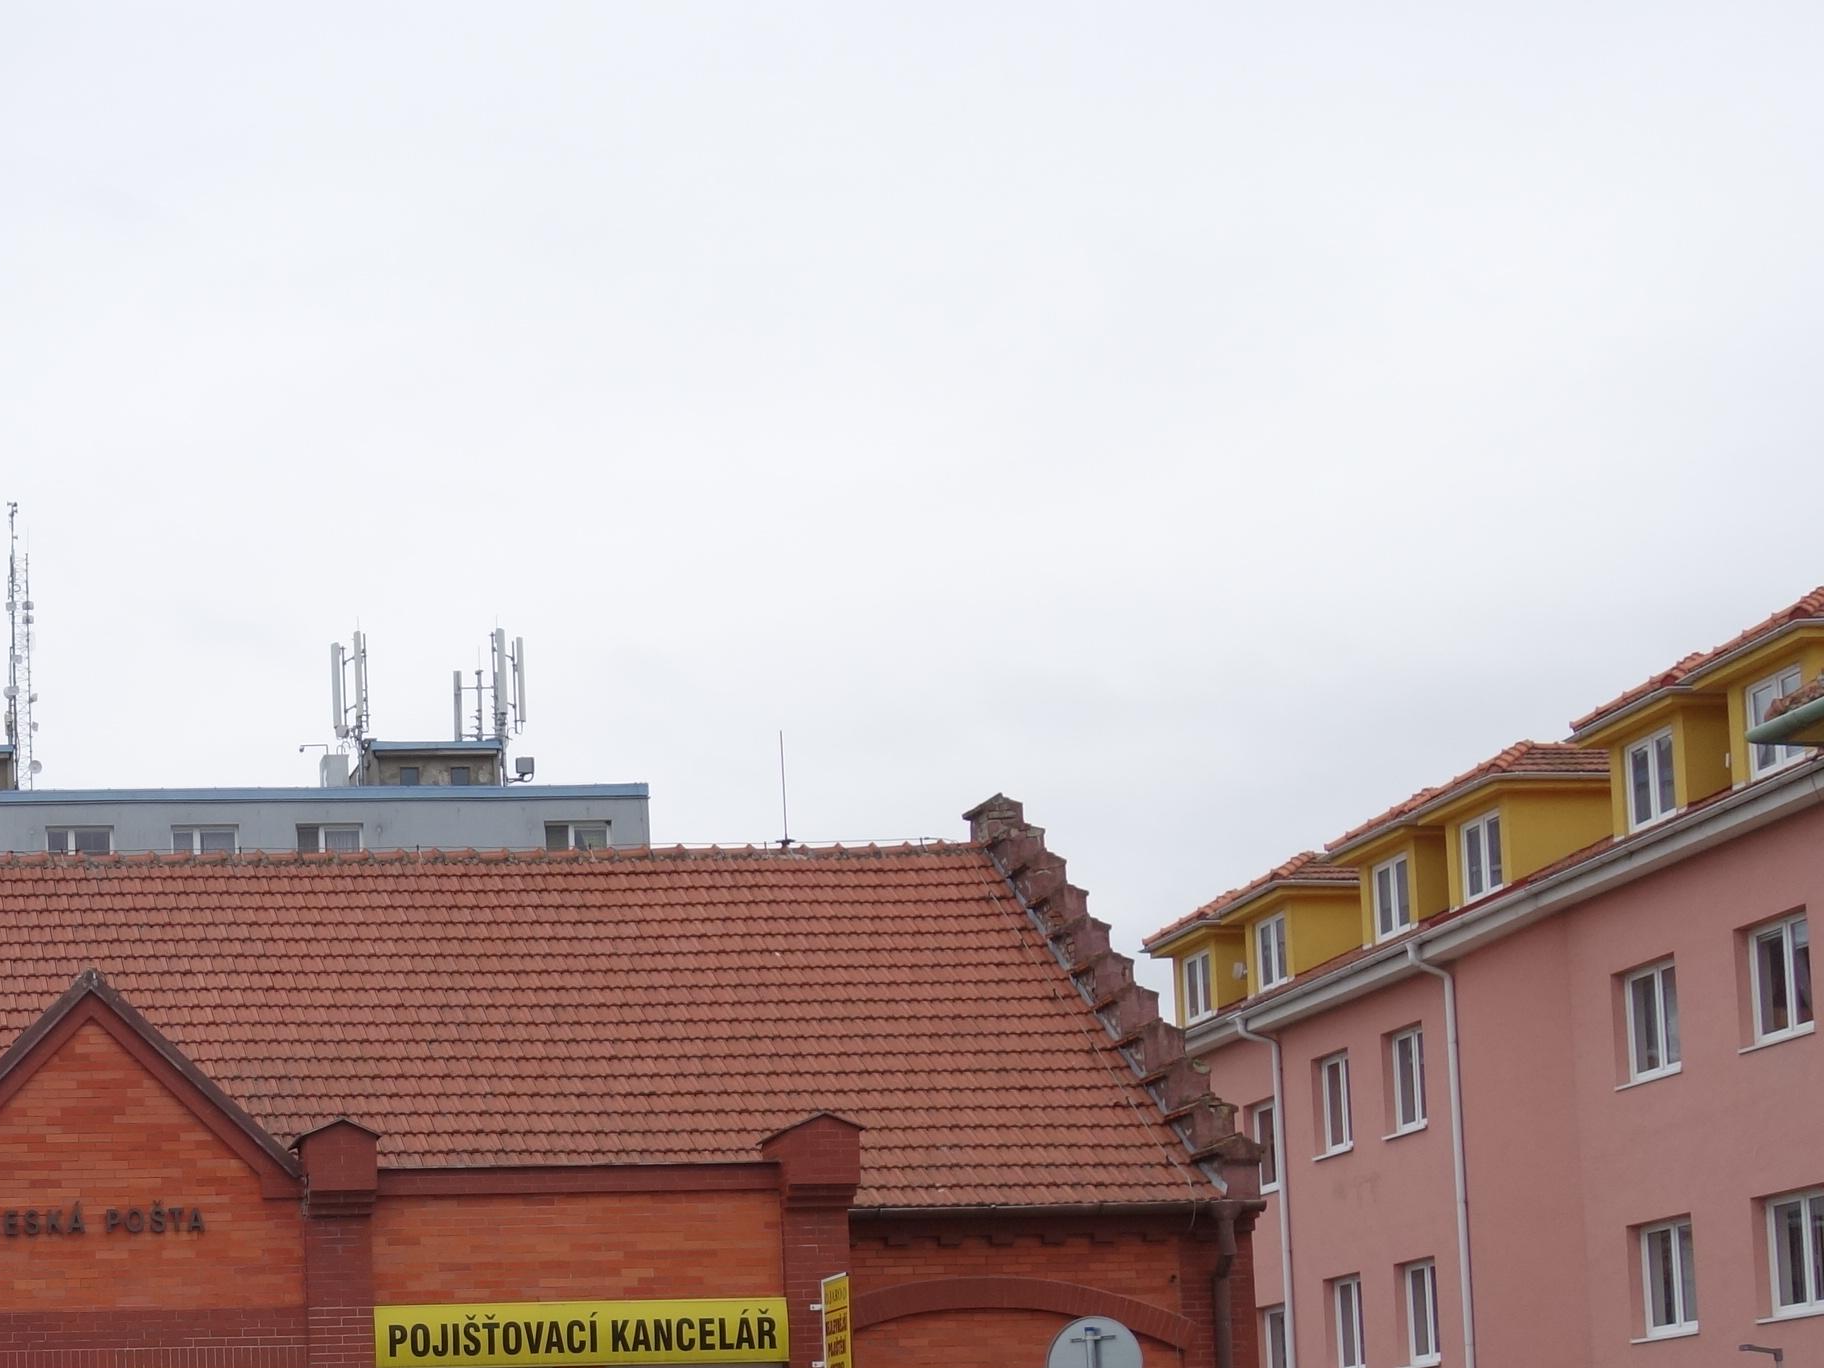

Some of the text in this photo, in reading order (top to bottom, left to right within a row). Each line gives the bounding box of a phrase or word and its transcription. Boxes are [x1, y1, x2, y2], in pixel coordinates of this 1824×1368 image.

[105, 1200, 205, 1234] POŠTA
[388, 1308, 777, 1358] POJIŠŤOVACÍ KANCELÁŘ
